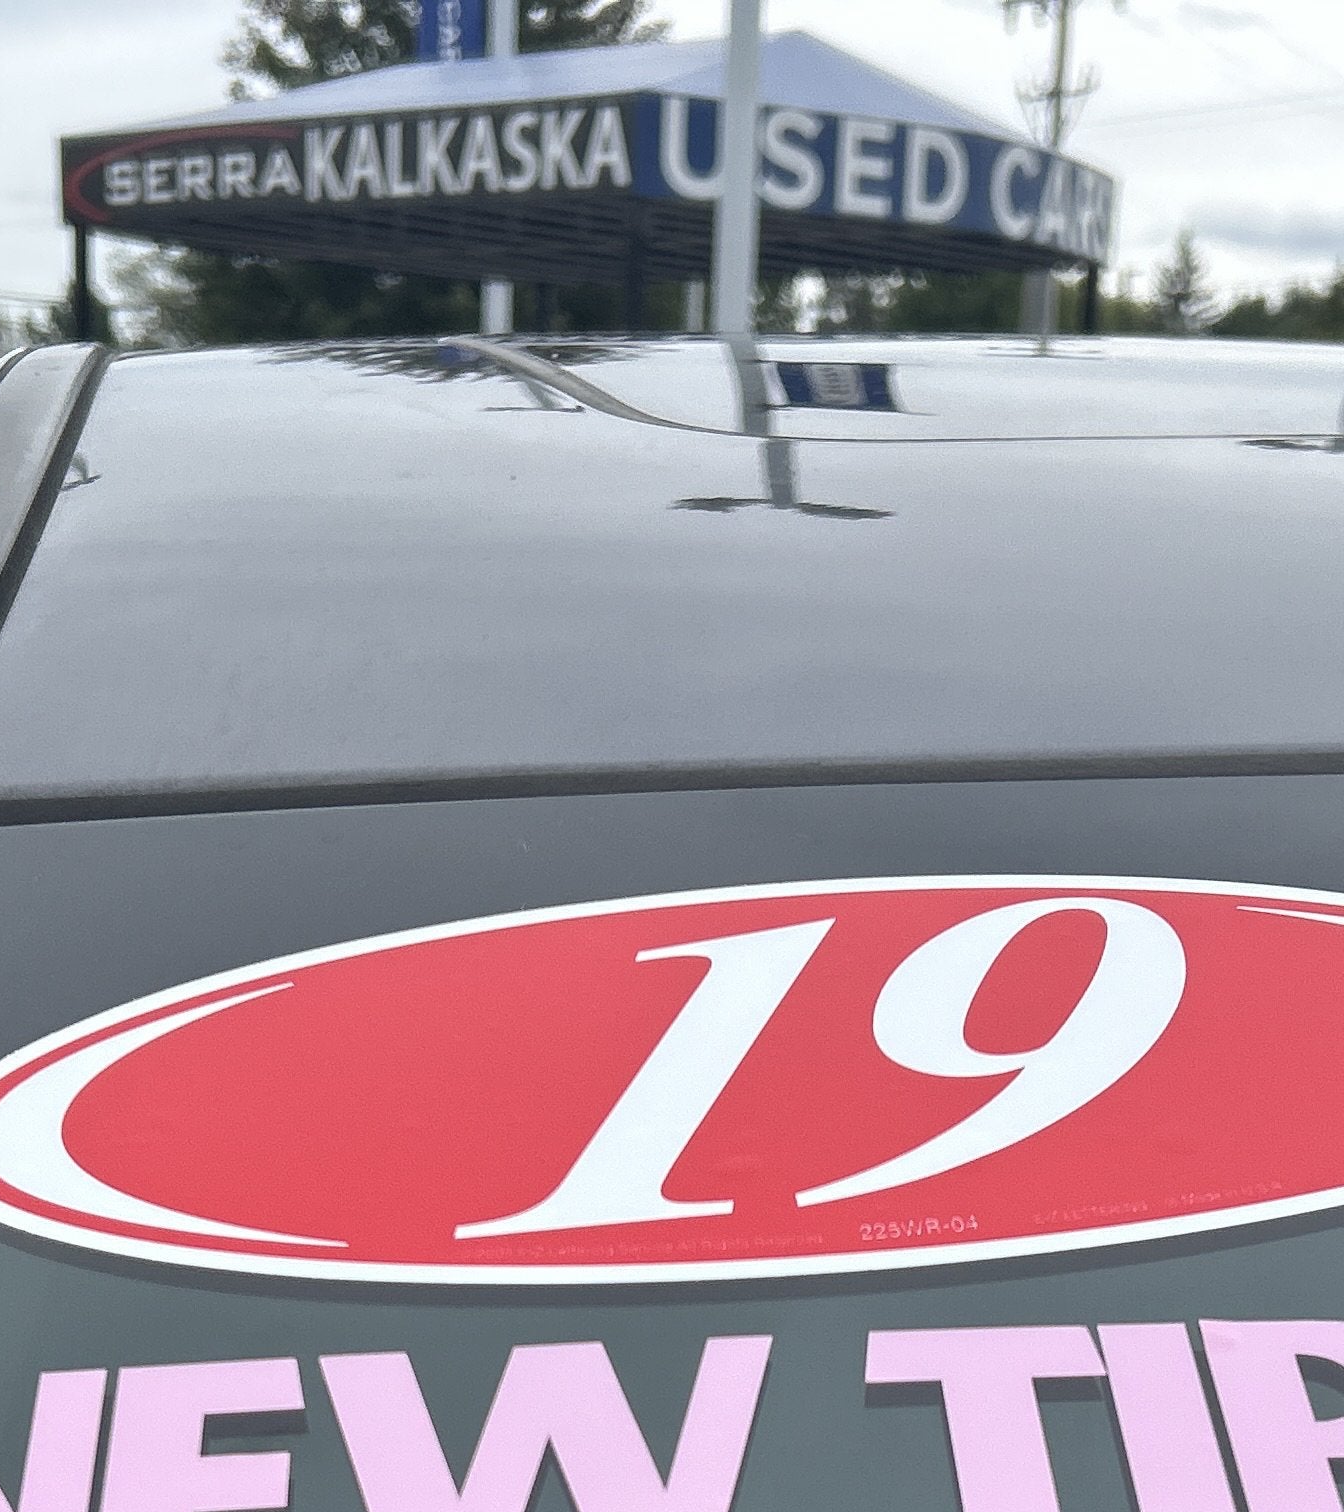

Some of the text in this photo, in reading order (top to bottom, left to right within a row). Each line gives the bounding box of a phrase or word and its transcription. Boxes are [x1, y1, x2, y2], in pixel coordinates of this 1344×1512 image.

[103, 102, 633, 206] SERRA KALKASKA
[659, 96, 970, 226] USED
[455, 897, 1187, 1238] 19
